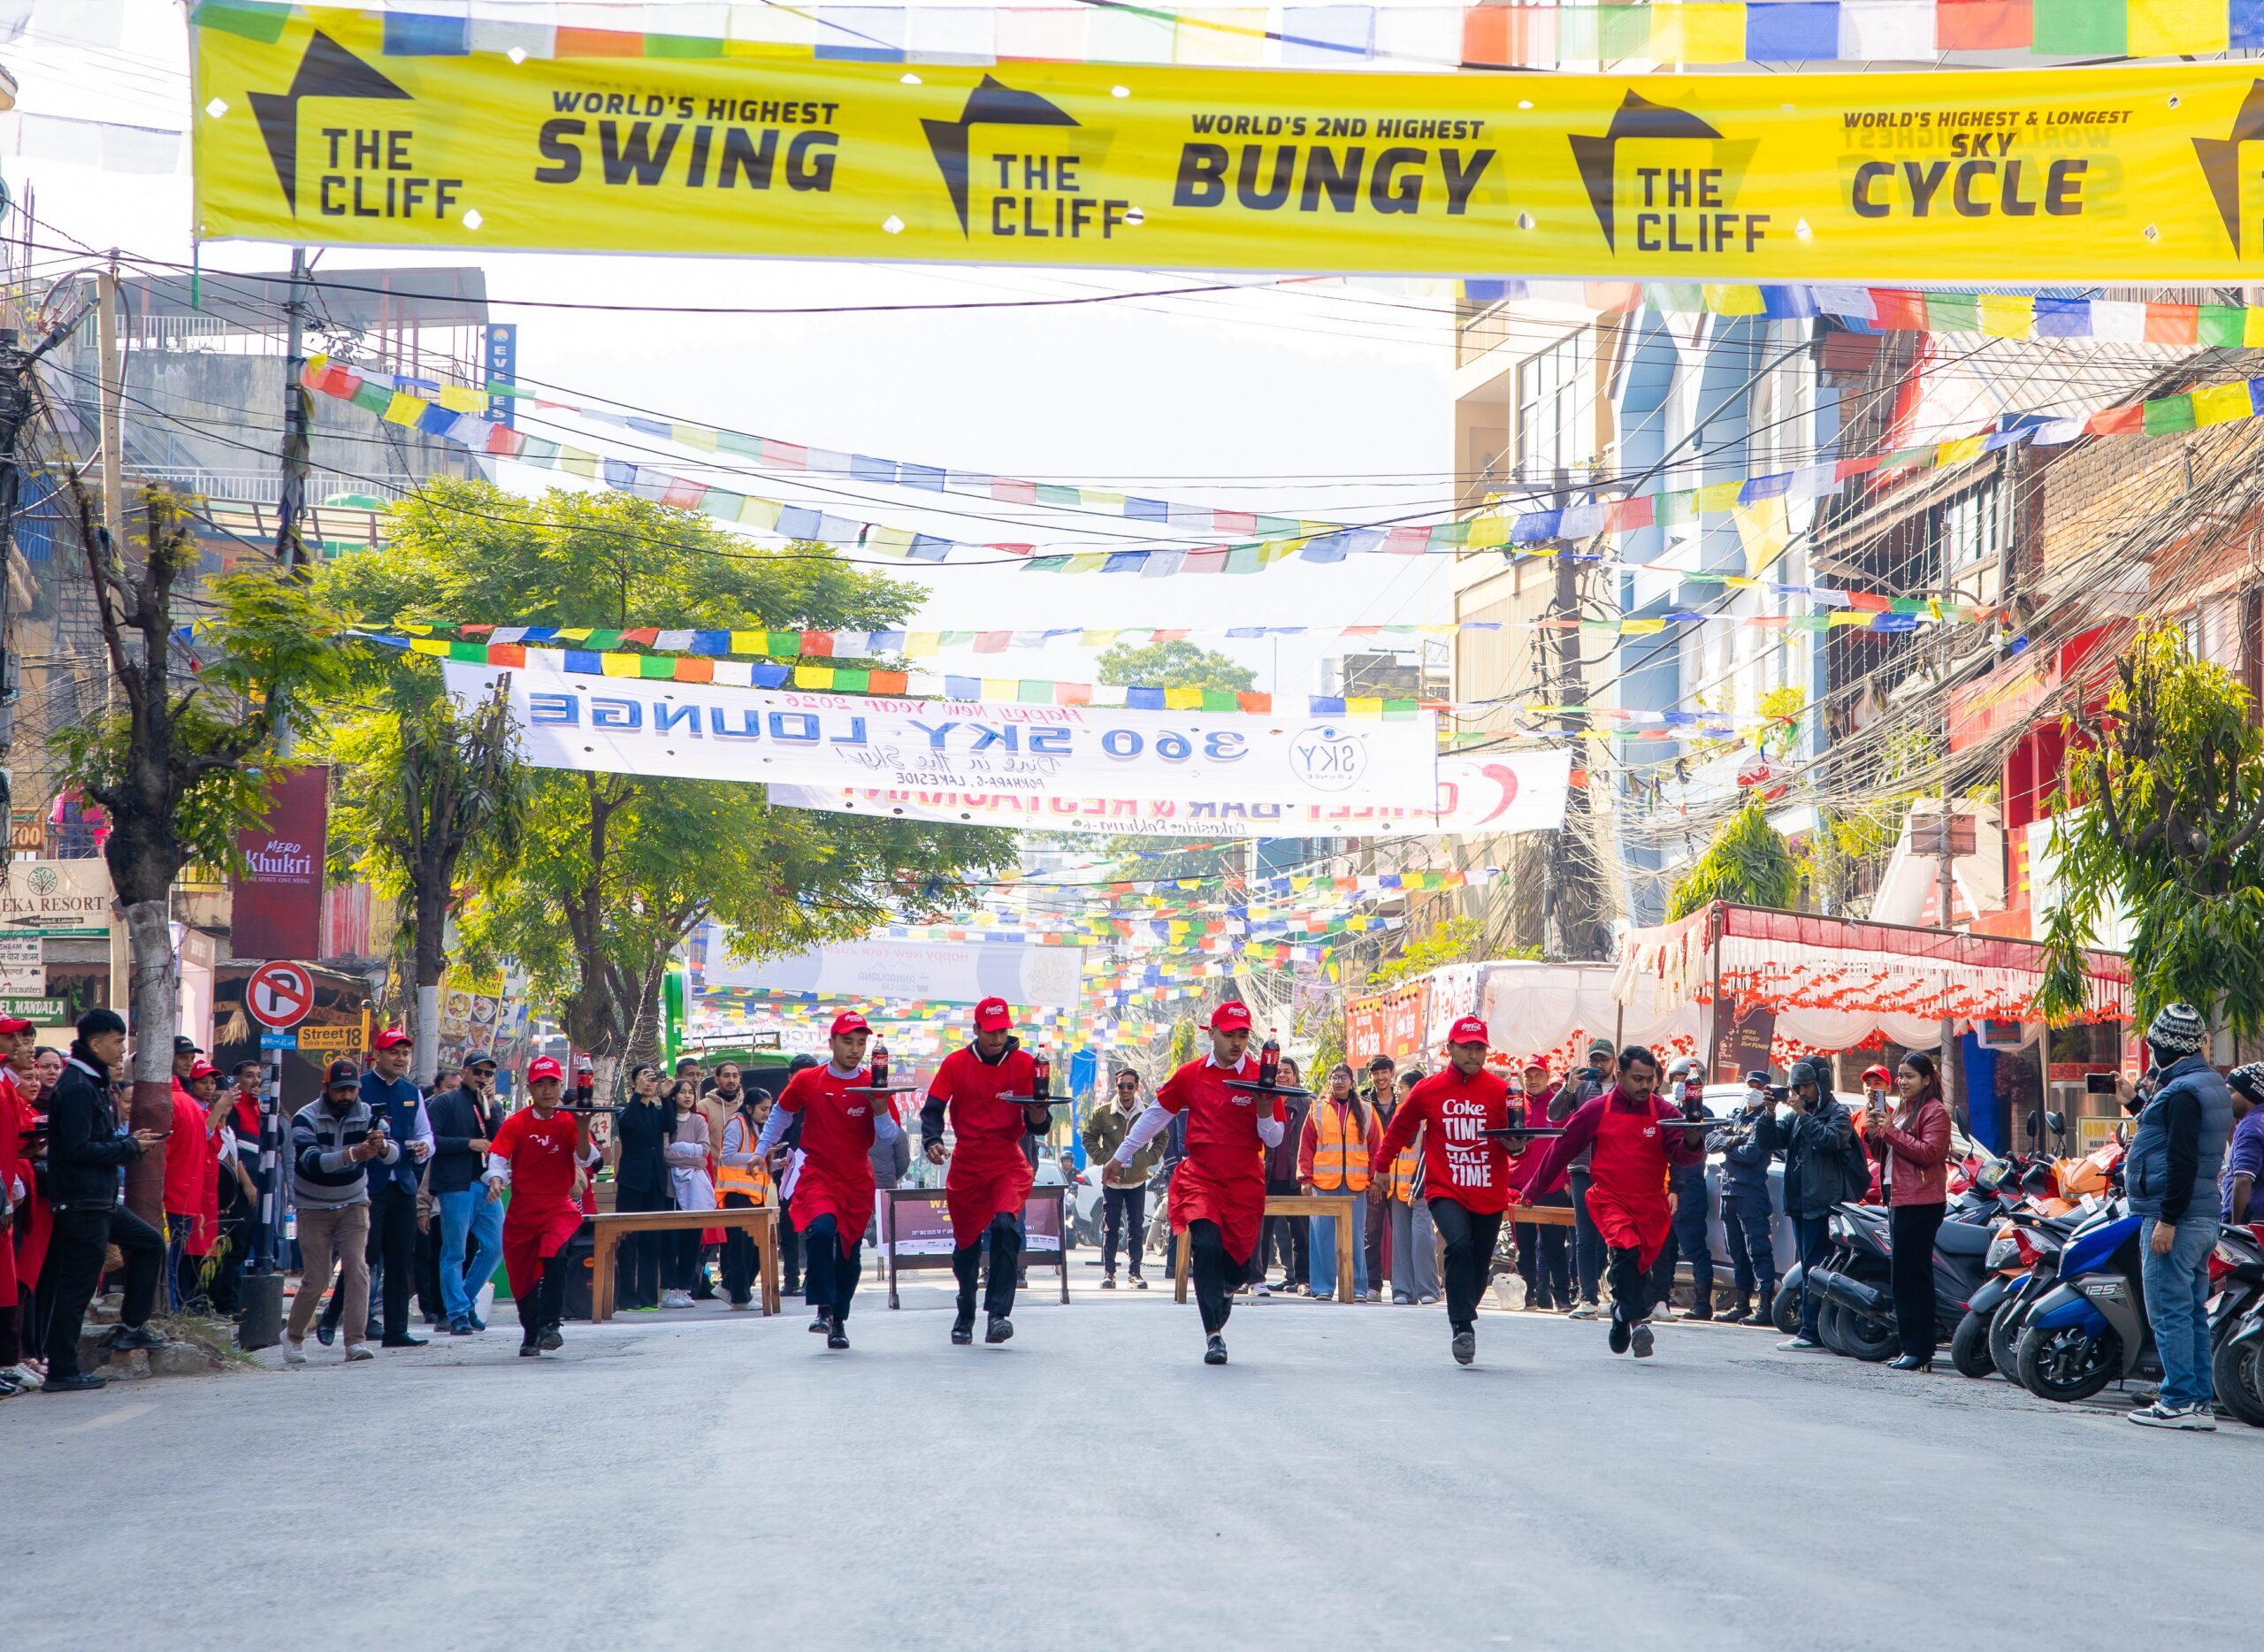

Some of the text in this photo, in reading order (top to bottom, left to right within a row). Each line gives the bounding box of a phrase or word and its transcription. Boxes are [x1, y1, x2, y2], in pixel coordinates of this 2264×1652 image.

[553, 91, 839, 126] WORLD'S HIGHEST
[1842, 110, 2133, 127] WORLD'S HIGHEST & LONGEST
[1191, 114, 1486, 140] WORLD'S 2ND HIGHEST
[321, 127, 413, 171] THE
[534, 119, 839, 193] SWING
[1950, 133, 2016, 157] SKY
[991, 154, 1080, 192] THE
[1173, 141, 1496, 215] BUNGY
[321, 175, 463, 219] CLIFF
[1636, 167, 1724, 208] THE
[1851, 159, 2088, 218] CYCLE
[991, 196, 1129, 240] CLIFF
[1636, 213, 1771, 253] CLIFF
[493, 345, 508, 424] EVEES
[265, 839, 302, 853] MERO
[245, 849, 311, 875] Khukri
[3, 896, 104, 912] EKA RESORT
[8, 985, 42, 994] encounters
[14, 1000, 64, 1015] MANDALA
[302, 1029, 344, 1040] Street
[345, 1028, 362, 1046] 18
[887, 1075, 914, 1083] FESTIVAL
[1442, 1099, 1486, 1116] Coke
[1442, 1117, 1488, 1141] TIME
[2084, 1121, 2106, 1137] OM
[1447, 1151, 1490, 1164] HALF
[1449, 1163, 1493, 1187] TIME
[2085, 1283, 2117, 1296] 125
